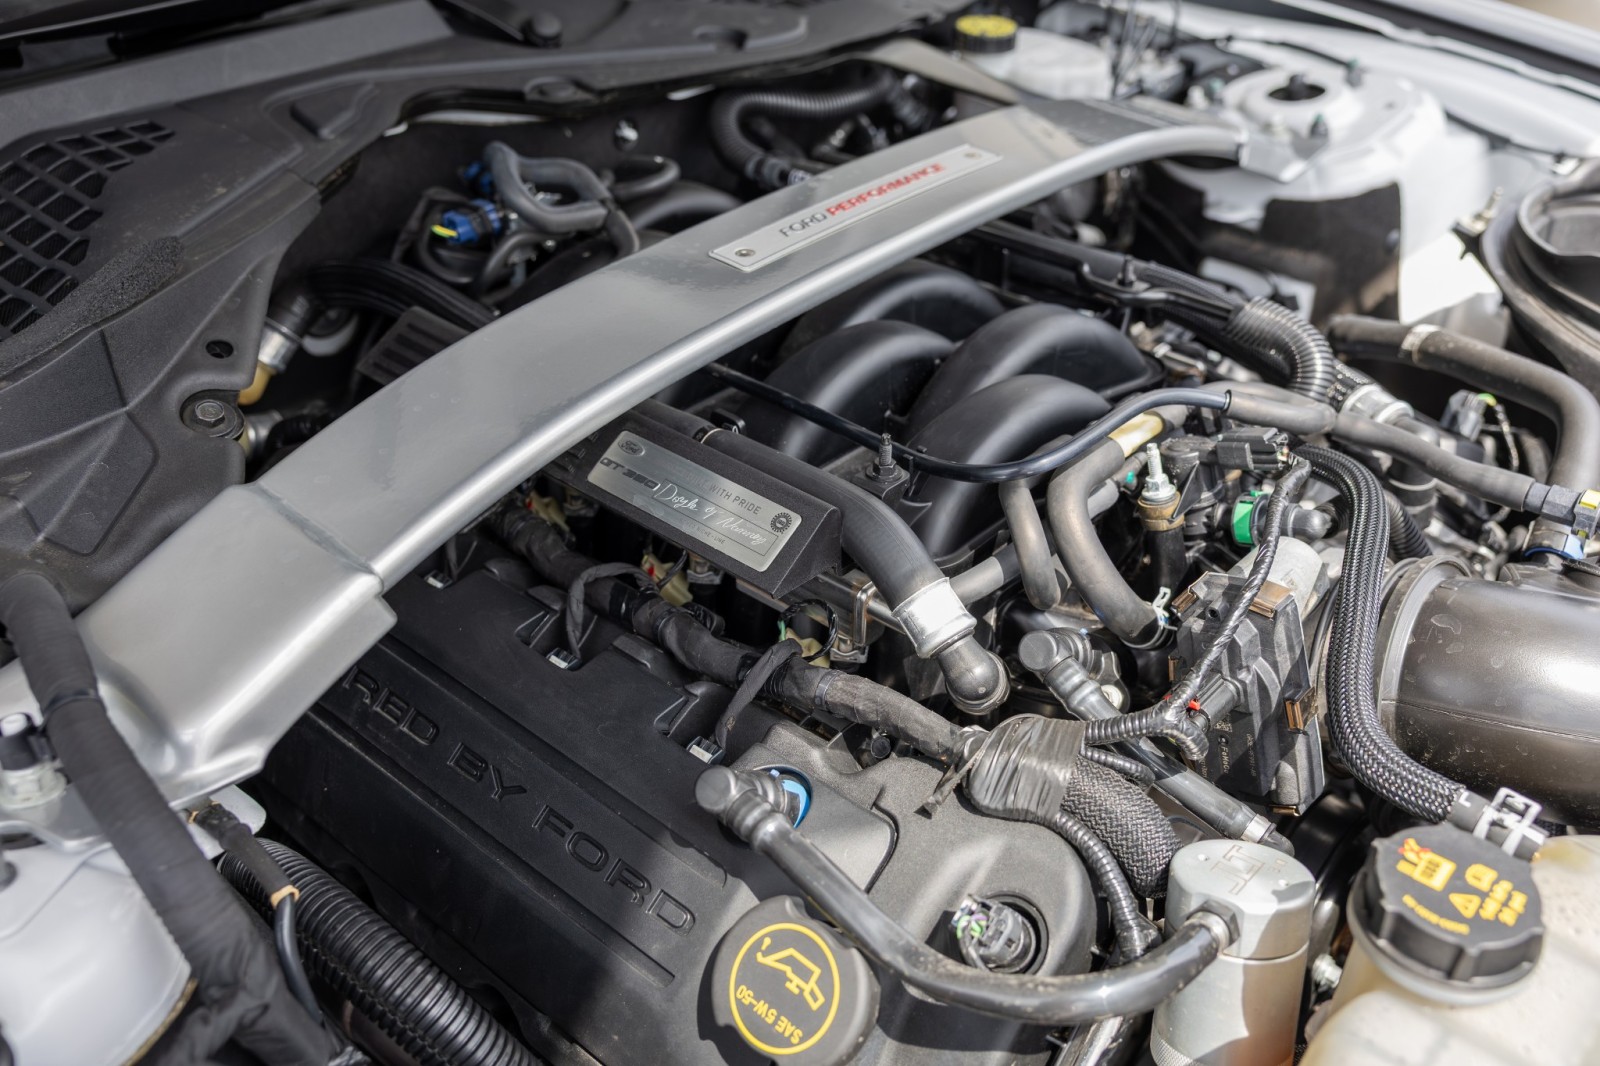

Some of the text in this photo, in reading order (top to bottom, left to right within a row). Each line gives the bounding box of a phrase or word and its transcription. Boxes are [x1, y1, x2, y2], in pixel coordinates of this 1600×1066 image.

[778, 162, 947, 237] FORD PERFORMANCE
[708, 483, 734, 501] WITH
[732, 495, 762, 516] PRIDE
[1220, 746, 1230, 774] FoMoCo
[447, 742, 527, 800] BY
[532, 804, 696, 936] FORD
[736, 984, 803, 1045] SAE 5W-50
